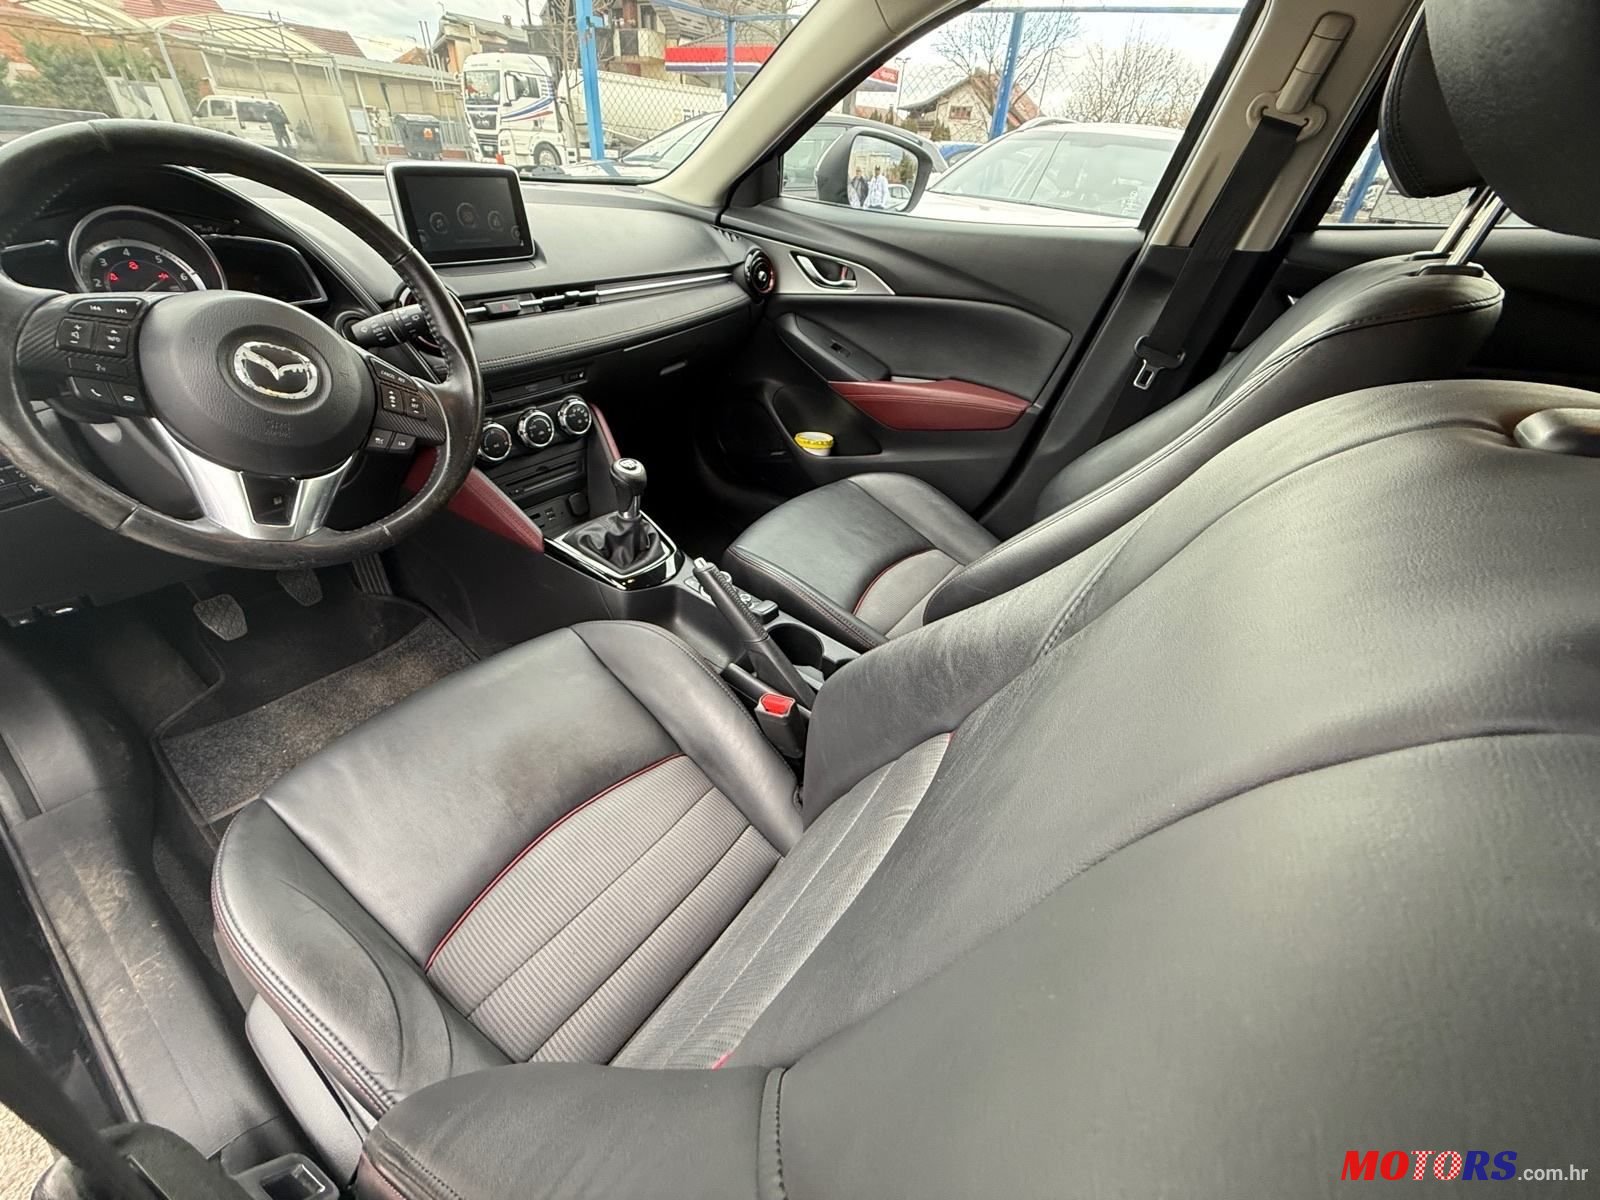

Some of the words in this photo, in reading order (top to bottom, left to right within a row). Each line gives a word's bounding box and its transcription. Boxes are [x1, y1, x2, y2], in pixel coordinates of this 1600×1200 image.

[122, 247, 131, 257] 4
[99, 257, 108, 267] 3
[155, 255, 163, 264] 5
[180, 272, 188, 281] 6
[93, 278, 102, 288] 2
